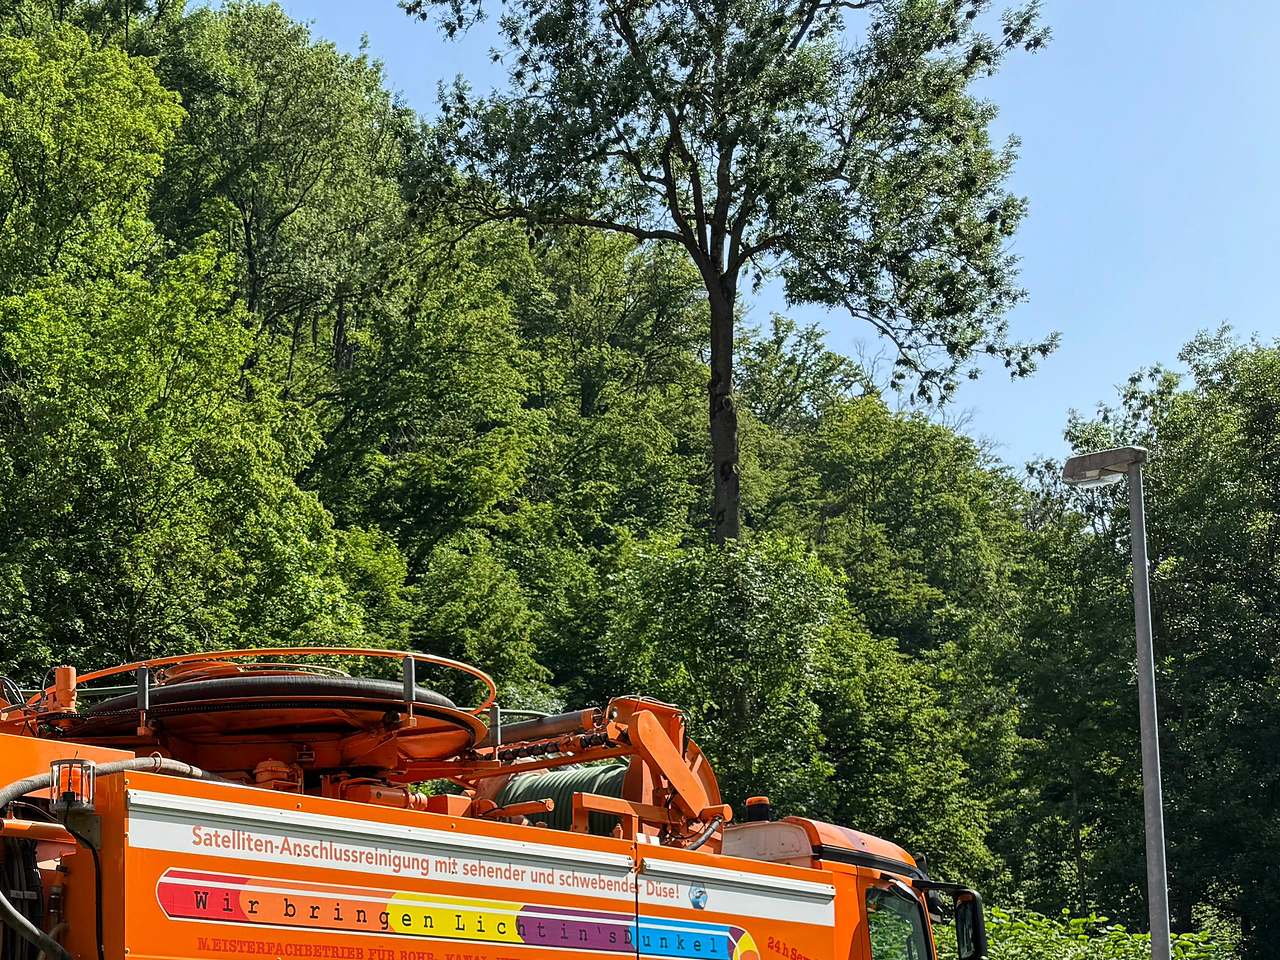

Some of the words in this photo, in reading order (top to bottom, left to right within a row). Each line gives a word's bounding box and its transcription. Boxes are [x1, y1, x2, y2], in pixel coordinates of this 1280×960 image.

[192, 824, 429, 876] Satelliten-Anschlussreinigung
[434, 857, 458, 875] mit
[463, 860, 526, 883] sehender
[531, 867, 555, 886] und
[560, 872, 642, 895] schwebender
[646, 880, 680, 899] Düse!
[198, 936, 364, 960] MEISTERFACHBETRIEB
